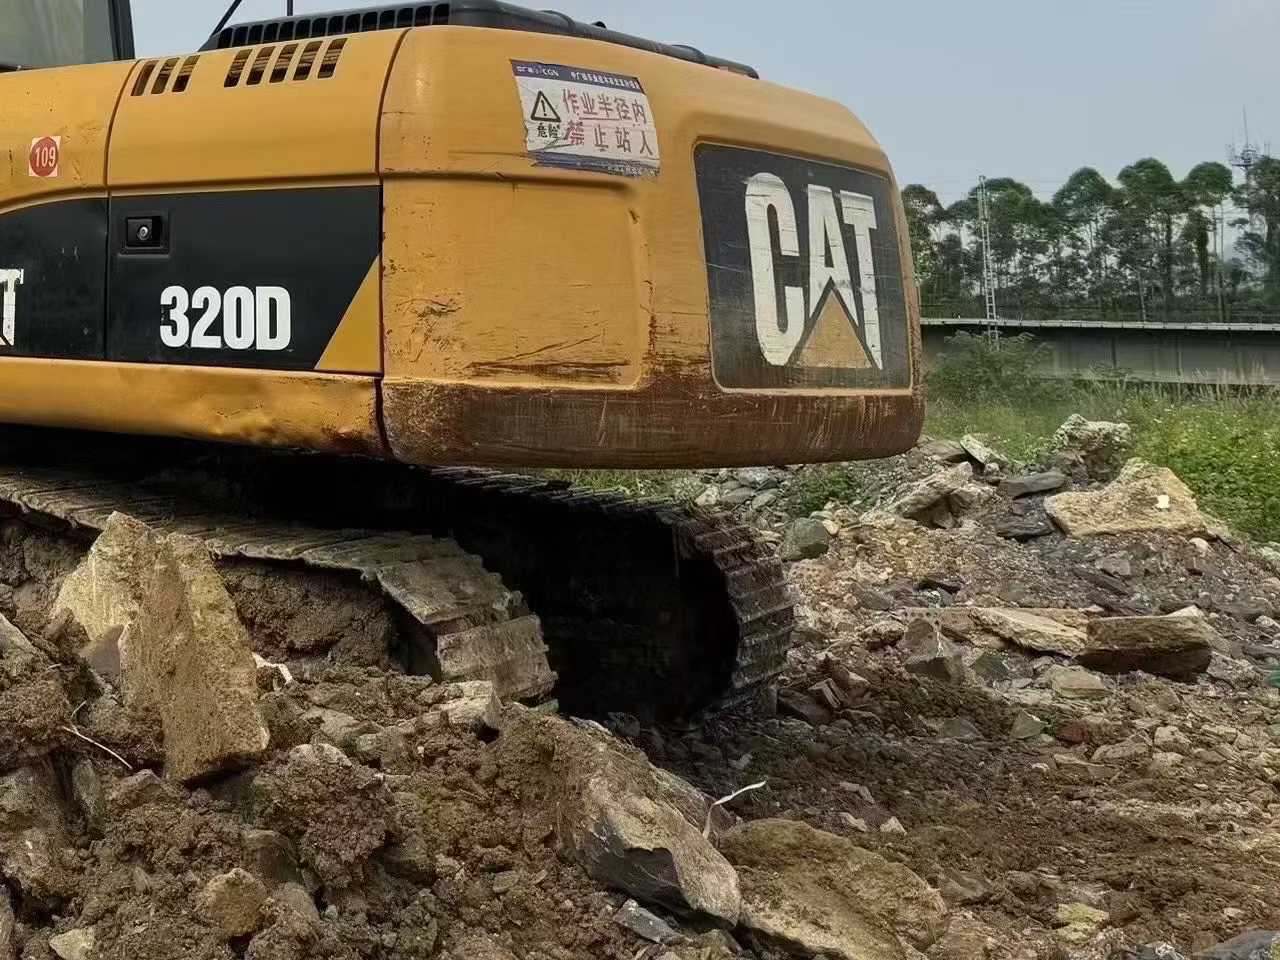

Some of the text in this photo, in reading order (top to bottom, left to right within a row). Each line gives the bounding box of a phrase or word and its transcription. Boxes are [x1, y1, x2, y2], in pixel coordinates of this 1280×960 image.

[542, 67, 559, 77] CGN
[562, 88, 647, 124] 作业半径内
[537, 123, 561, 139] 危险
[565, 120, 653, 155] 禁止站人
[35, 146, 56, 167] 109
[744, 172, 883, 370] CAT
[160, 286, 291, 351] 320D
